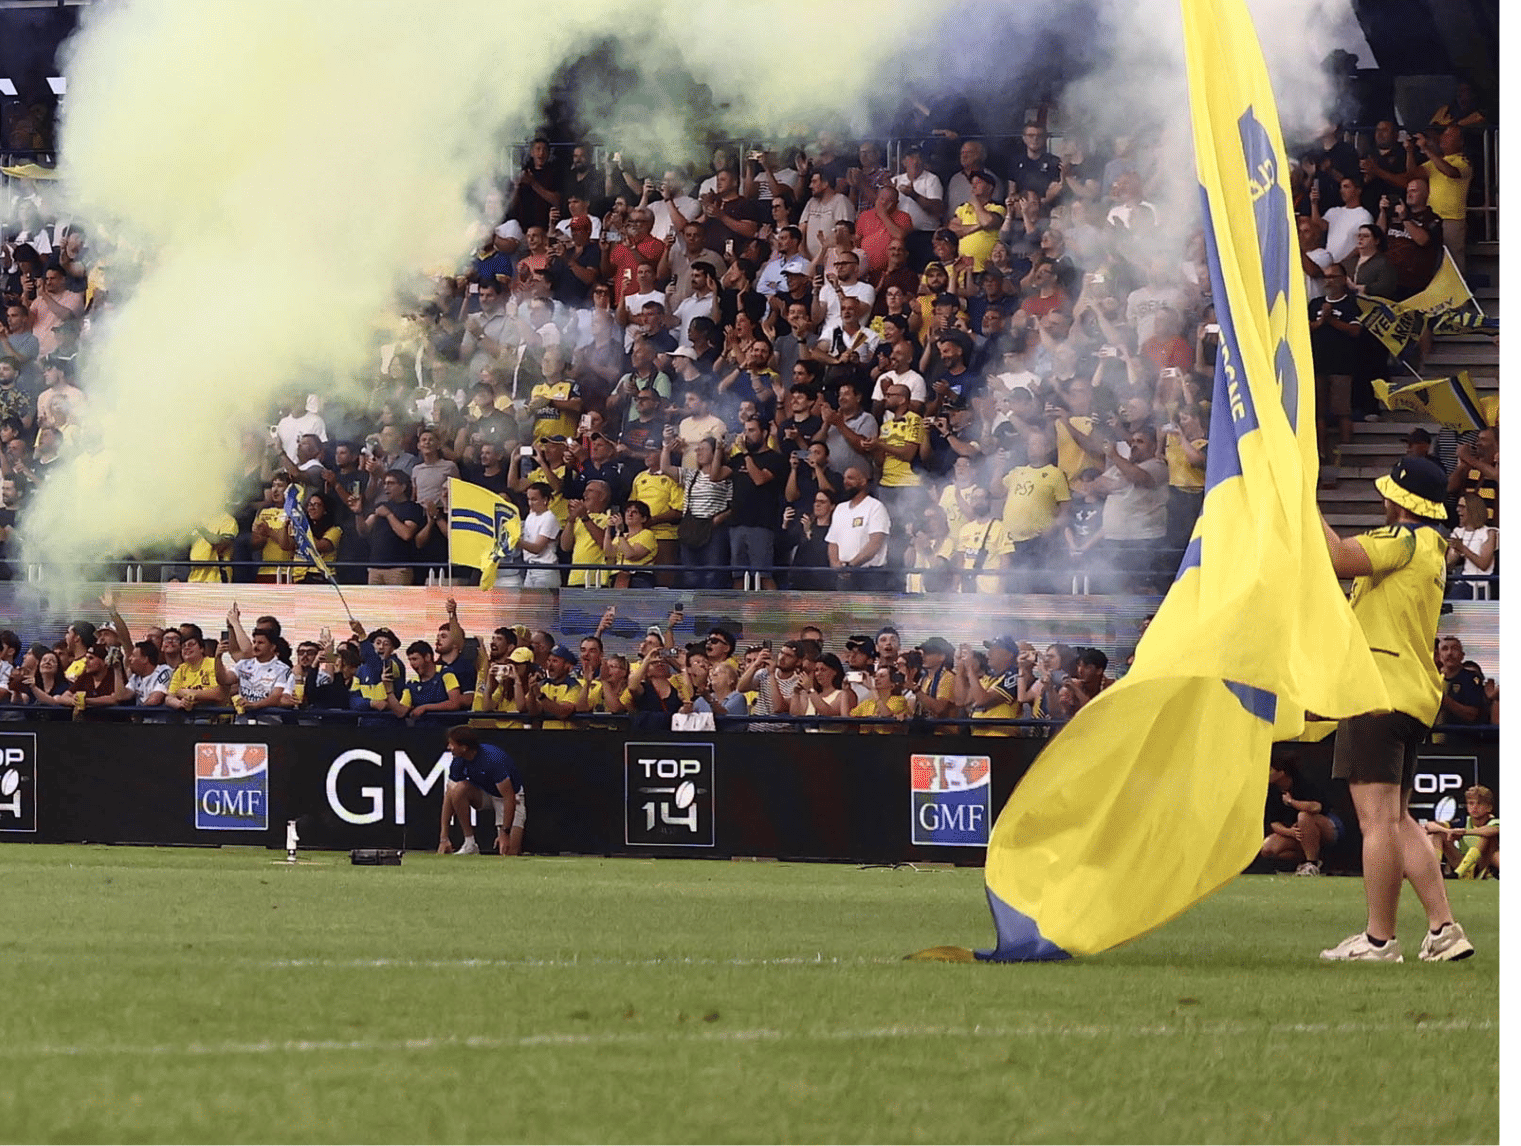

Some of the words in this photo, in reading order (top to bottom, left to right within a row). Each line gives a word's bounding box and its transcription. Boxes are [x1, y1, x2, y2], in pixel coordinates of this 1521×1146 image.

[638, 758, 701, 778] TOP
[326, 748, 477, 827] GM
[1414, 773, 1463, 793] OP
[202, 789, 262, 816] GMF
[642, 801, 698, 832] 14
[919, 803, 985, 831] GMF
